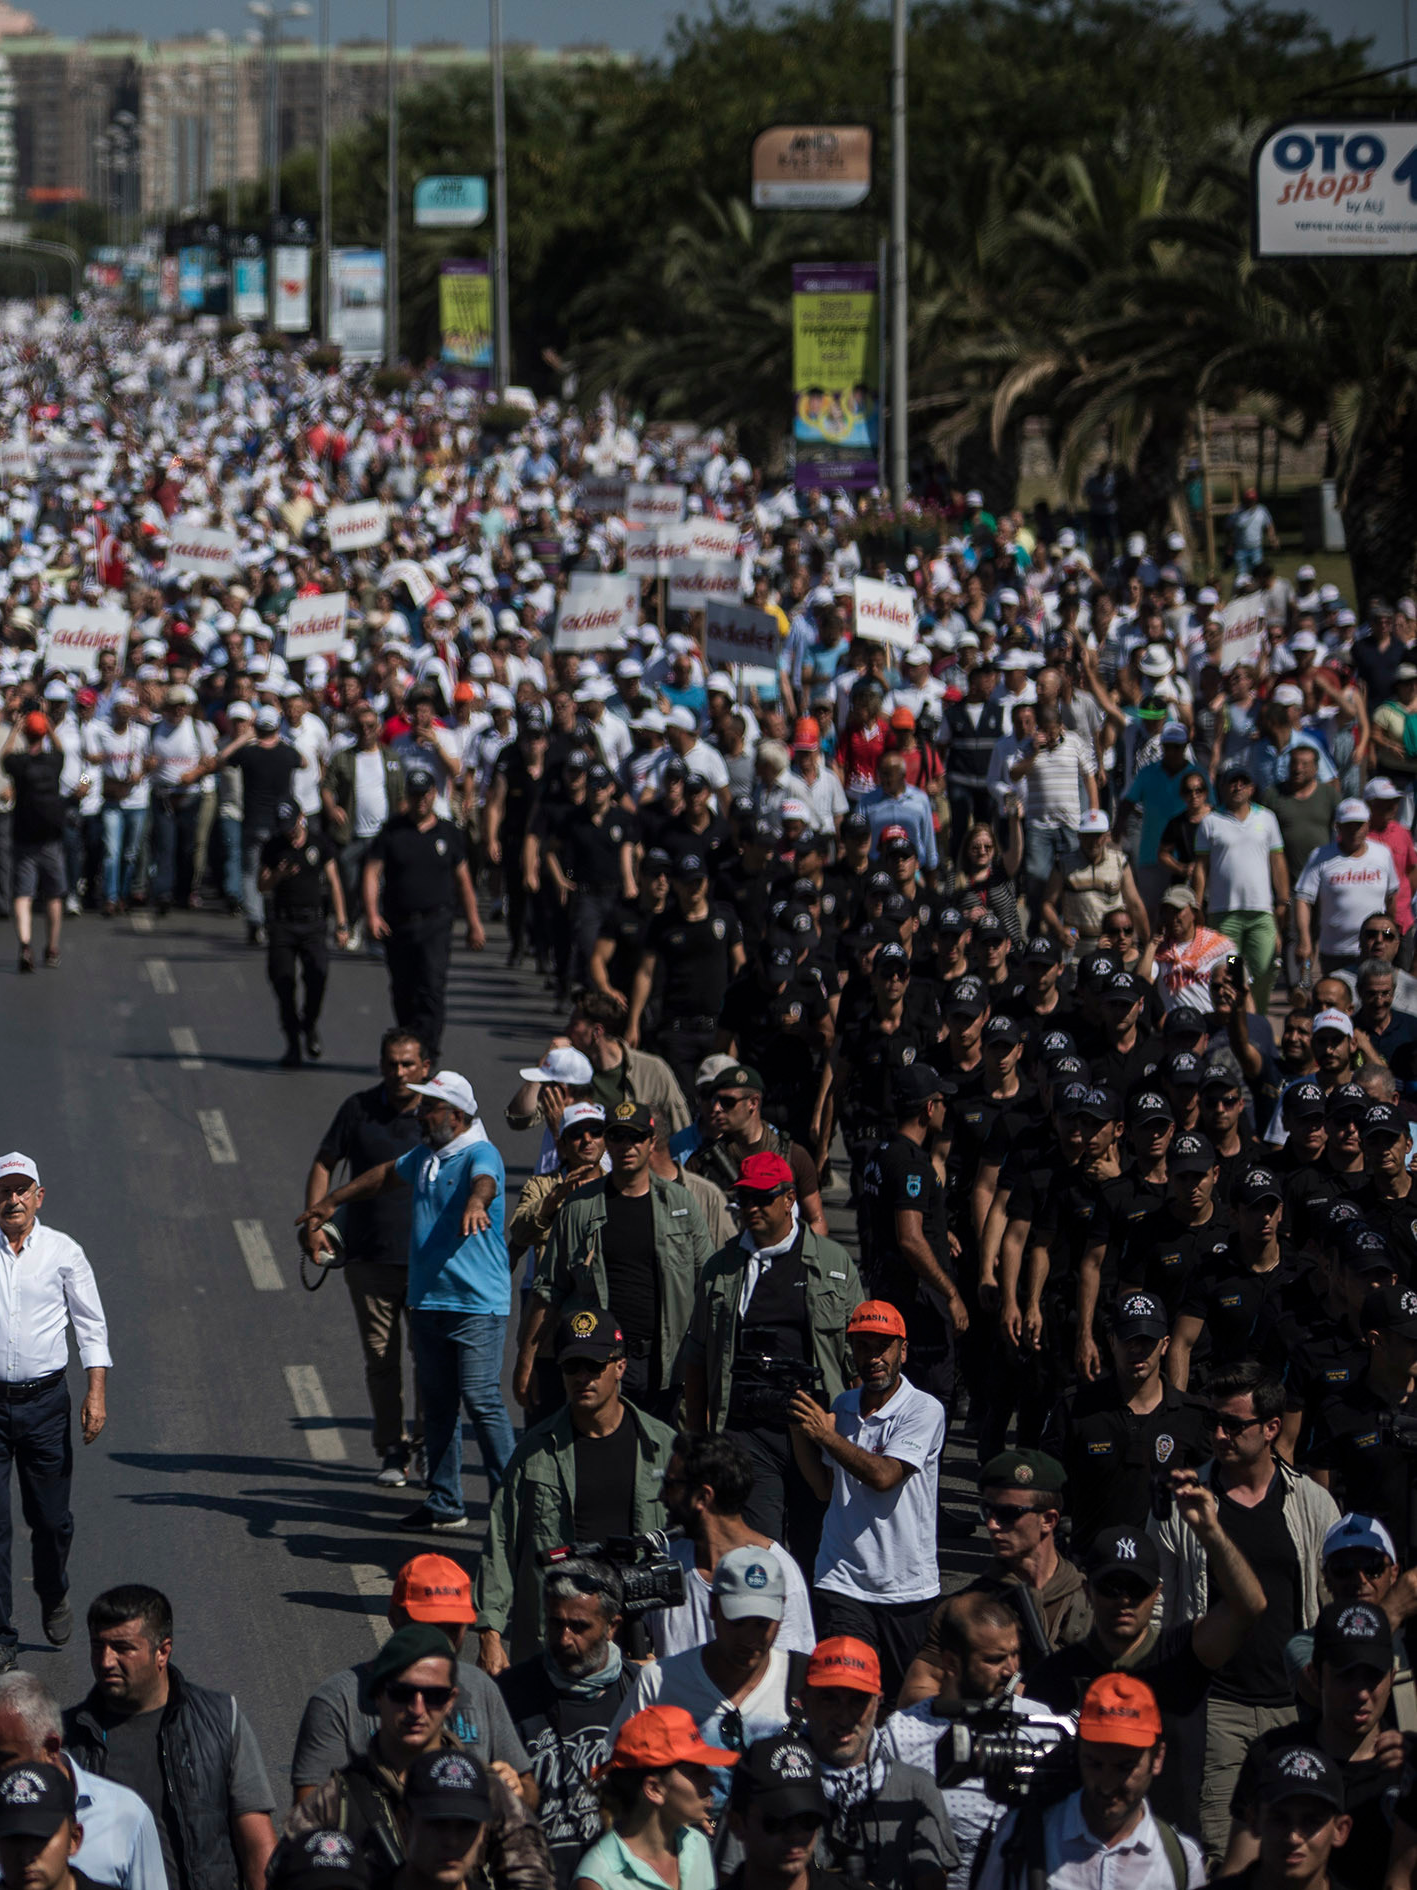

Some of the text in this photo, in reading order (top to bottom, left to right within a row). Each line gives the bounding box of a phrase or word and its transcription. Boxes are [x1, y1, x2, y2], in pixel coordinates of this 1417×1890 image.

[1273, 133, 1387, 174] OTO
[1276, 168, 1378, 207] shops
[1346, 200, 1361, 215] by
[859, 598, 915, 627] adalet
[289, 613, 345, 640] adalet
[52, 627, 123, 652] adalet
[1330, 868, 1383, 886] adalet
[860, 1313, 888, 1324] BASIN
[1116, 1535, 1136, 1560] NY
[424, 1585, 462, 1599] BASIN
[823, 1655, 866, 1671] BASIN
